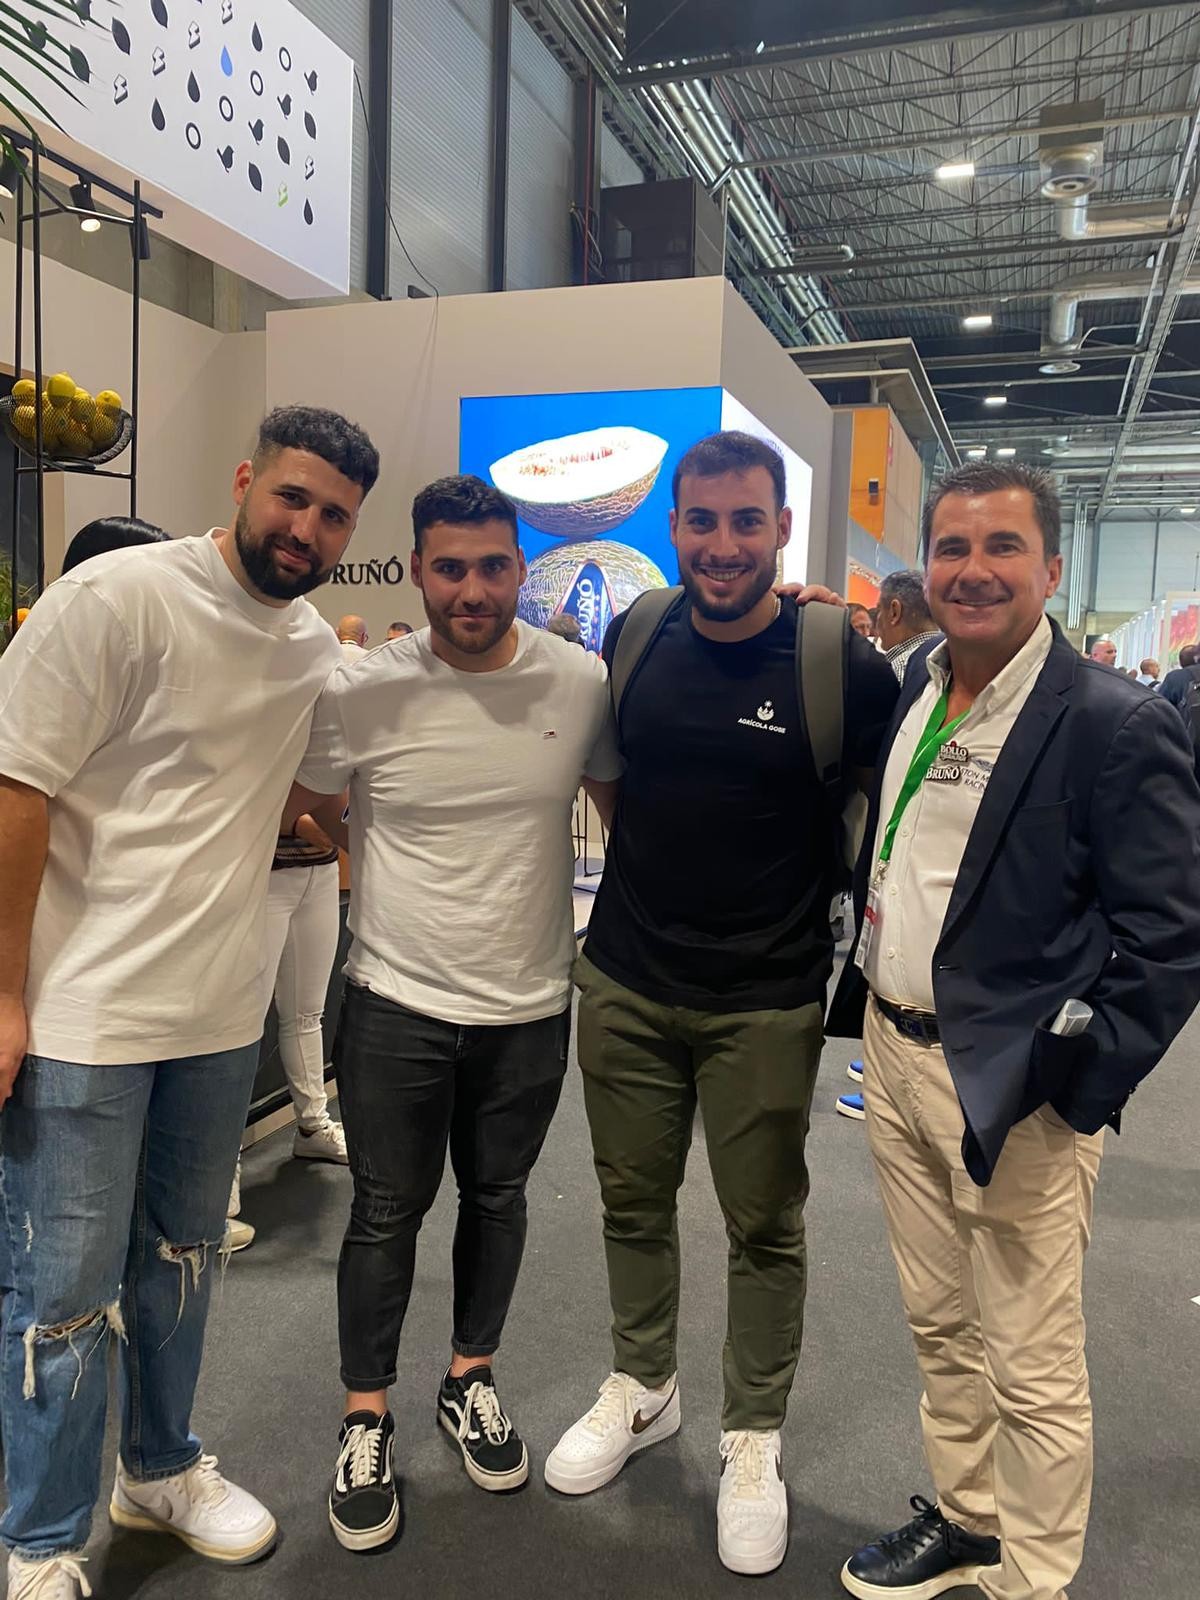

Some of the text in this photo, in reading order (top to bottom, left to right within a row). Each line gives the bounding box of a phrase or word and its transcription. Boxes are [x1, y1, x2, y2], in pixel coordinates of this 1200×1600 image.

[331, 555, 404, 585] RUÑÓ
[576, 578, 594, 643] RUÑÓ
[940, 744, 967, 757] BOLLO
[926, 765, 960, 780] BRUÑÓ
